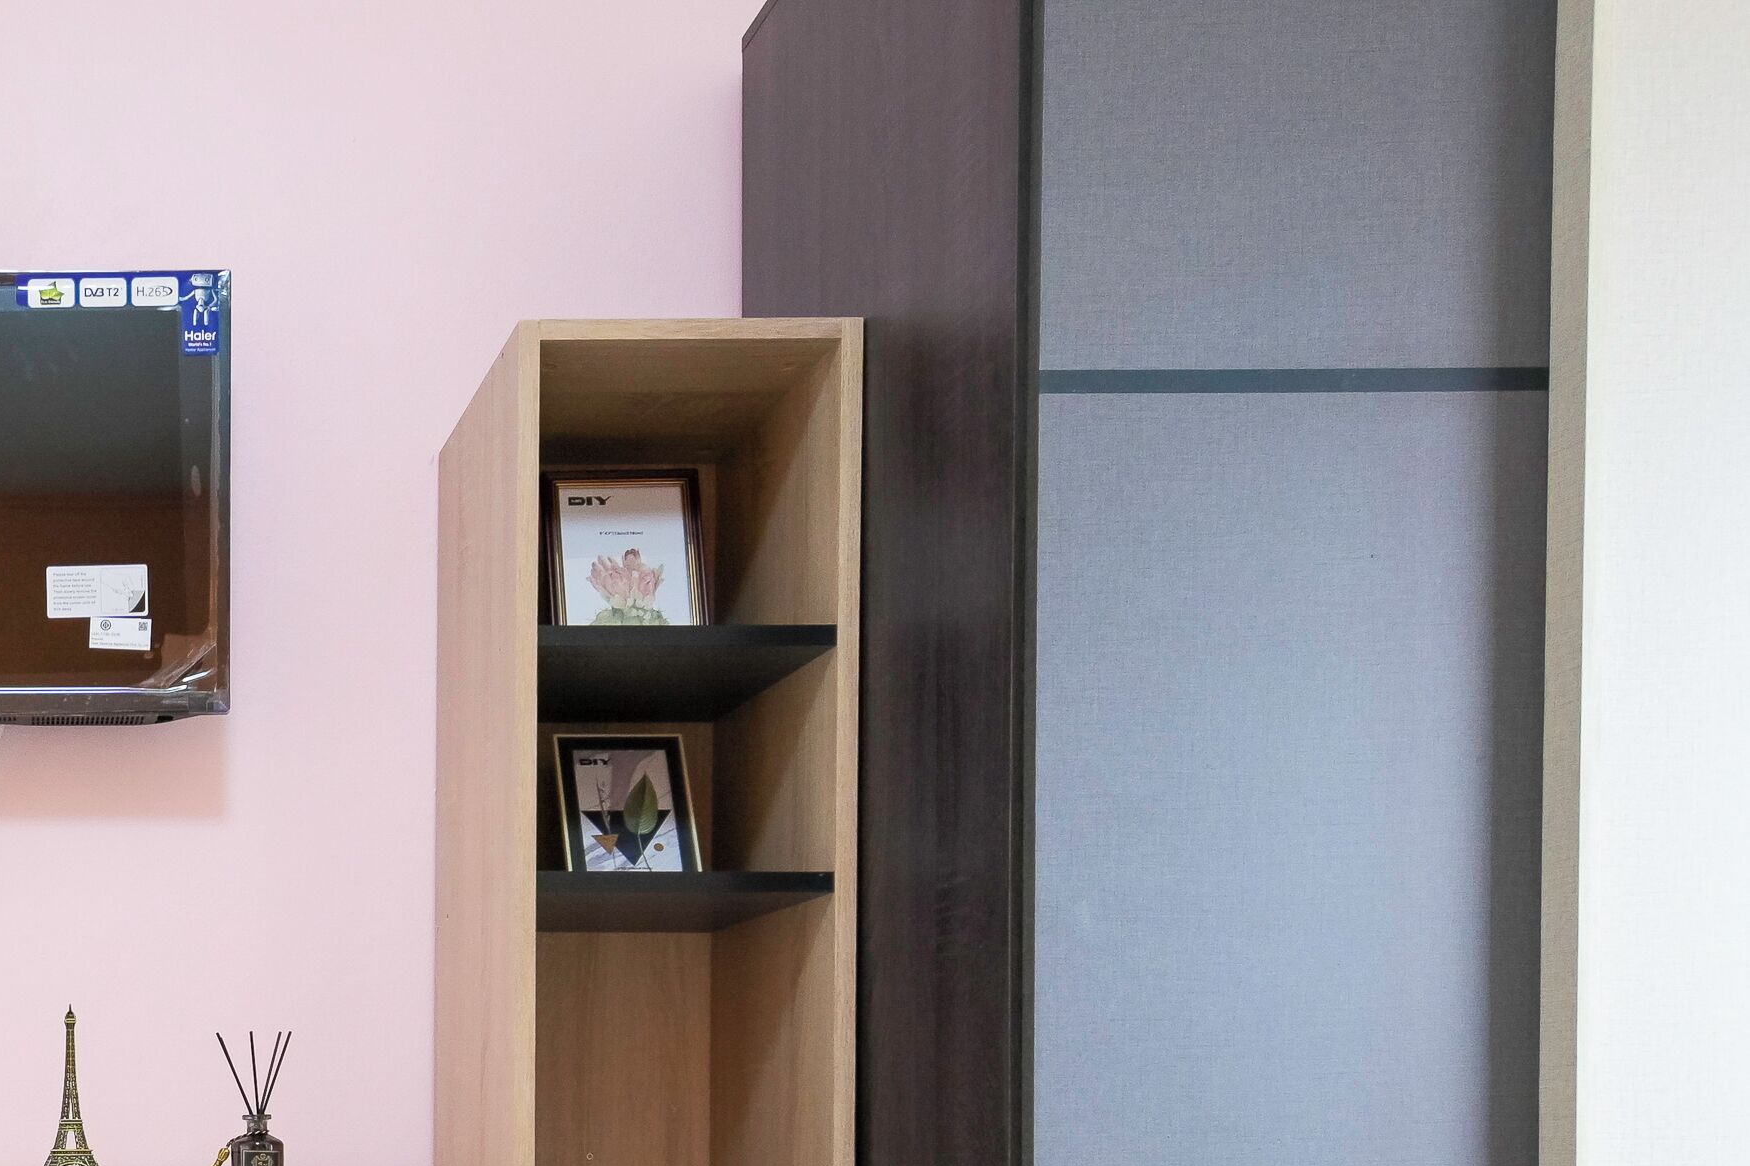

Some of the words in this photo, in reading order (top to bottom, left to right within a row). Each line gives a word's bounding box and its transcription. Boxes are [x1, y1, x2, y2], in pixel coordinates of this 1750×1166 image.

[184, 329, 217, 342] Haier
[568, 495, 612, 506] DIY
[578, 757, 612, 766] DIY
